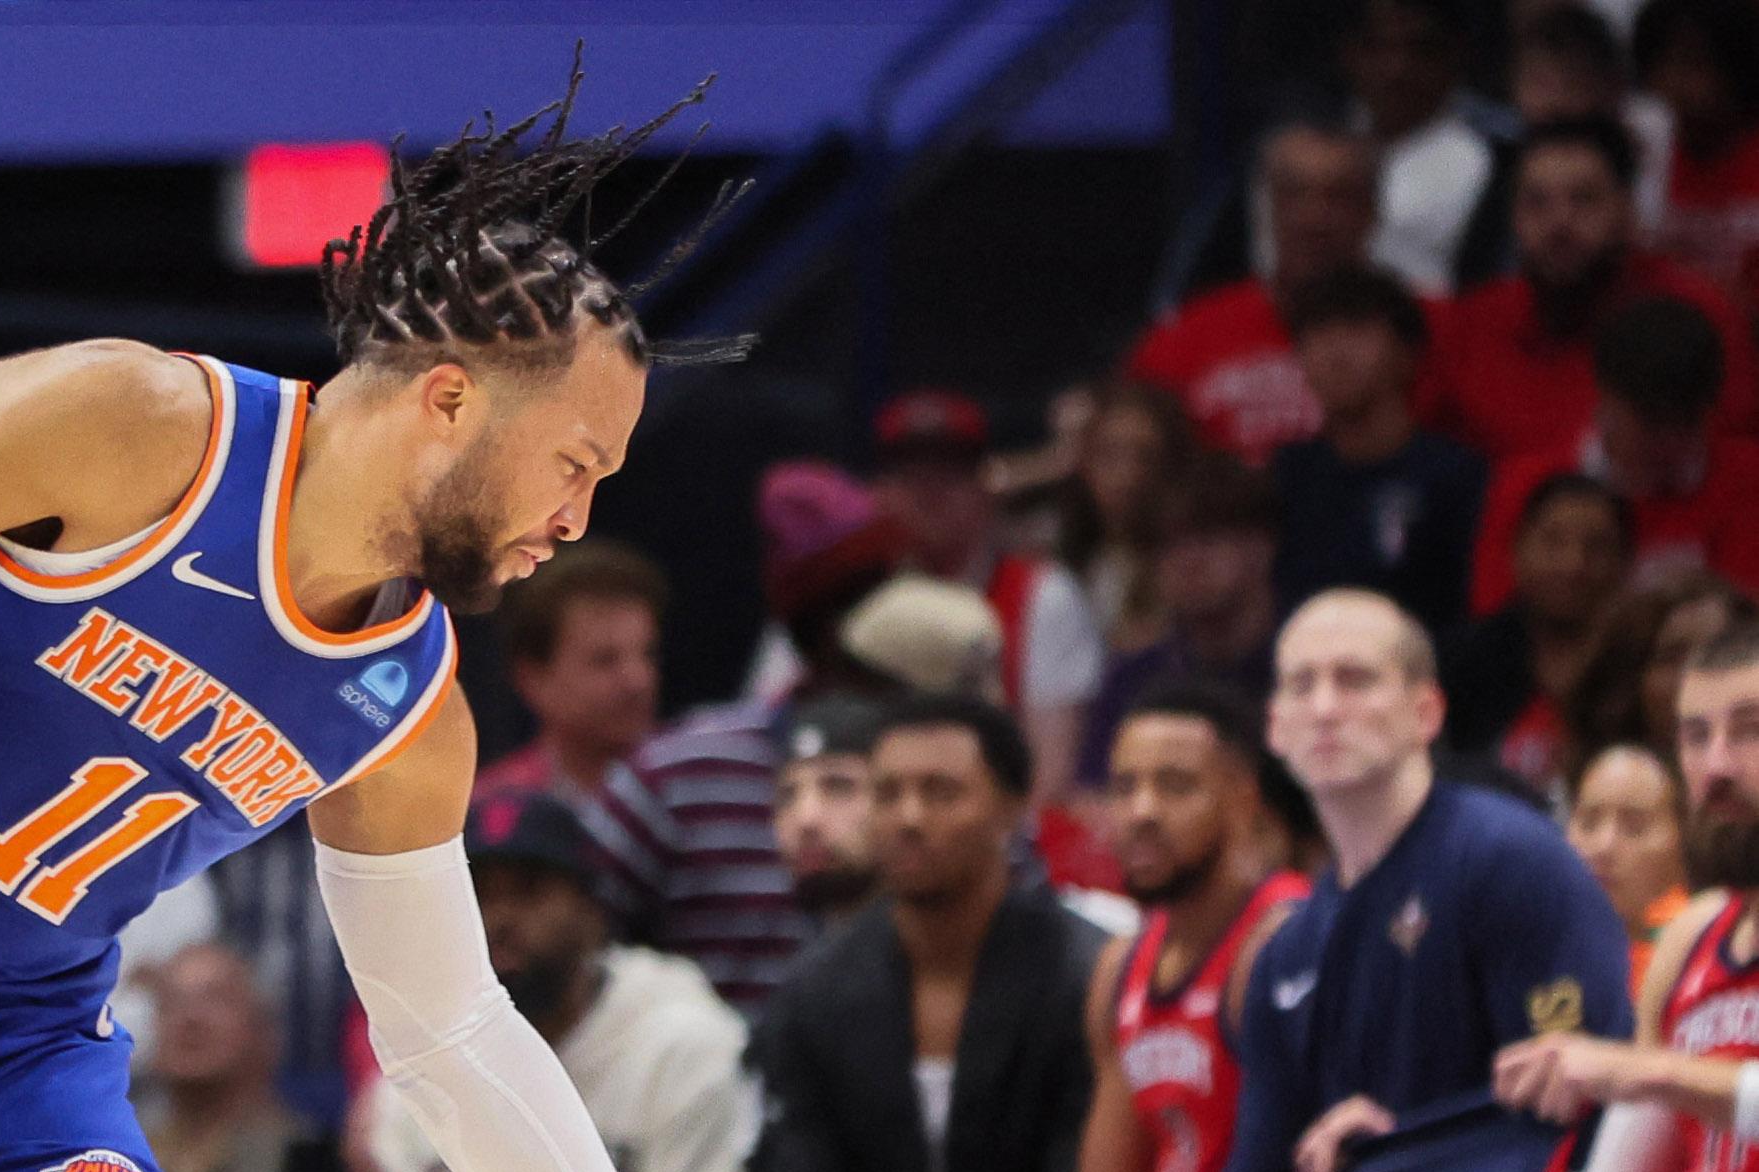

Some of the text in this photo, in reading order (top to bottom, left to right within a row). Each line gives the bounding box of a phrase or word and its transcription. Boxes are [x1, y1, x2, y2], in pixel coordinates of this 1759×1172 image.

[35, 606, 328, 828] NEW YORK
[339, 684, 391, 727] sphere
